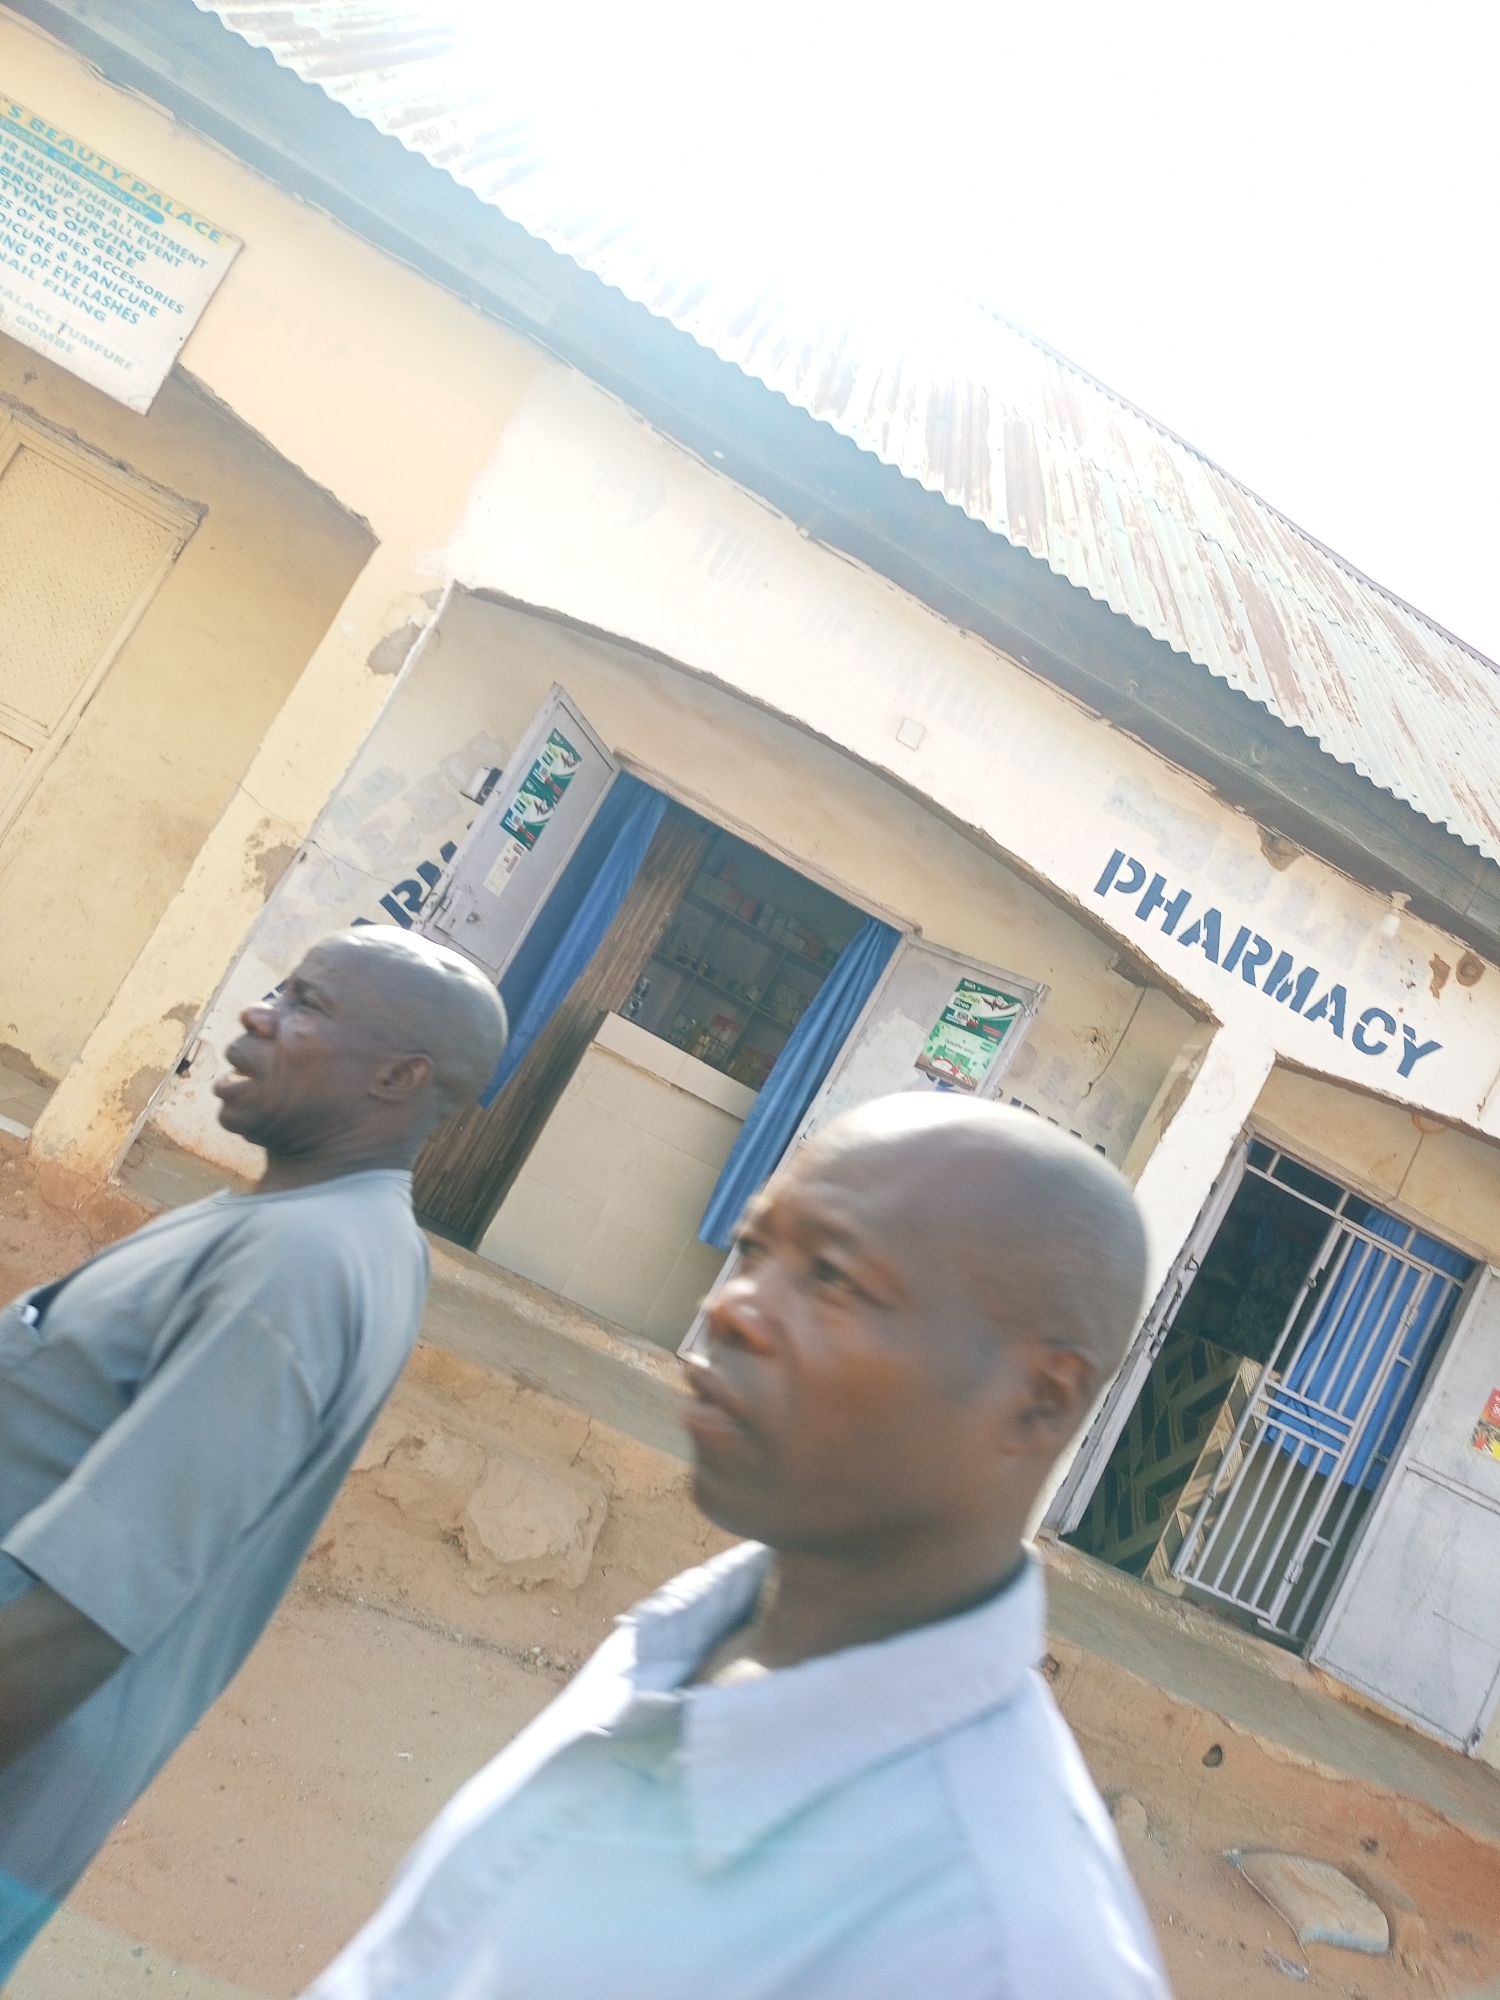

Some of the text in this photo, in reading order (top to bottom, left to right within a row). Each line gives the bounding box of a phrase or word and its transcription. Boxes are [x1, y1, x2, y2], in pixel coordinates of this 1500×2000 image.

[0, 134, 19, 153] IR
[22, 149, 122, 217] MAKING/HAIR
[127, 213, 208, 269] TREATMENT
[0, 165, 147, 262] BROW CURVING
[1, 151, 44, 183] MAKE
[77, 198, 104, 221] FOR
[108, 218, 132, 238] ALL
[137, 234, 184, 268] EVENT
[1, 178, 136, 269] TYING OF GELE
[29, 117, 125, 180] BEAUTY
[131, 180, 222, 244] PALACE
[16, 207, 36, 222] OF
[39, 220, 90, 256] LADIES
[92, 254, 184, 314] ACCESSORIES
[30, 252, 51, 269] OF
[52, 265, 81, 289] EYE
[82, 283, 140, 324] LASHES
[42, 277, 106, 322] FIXING
[56, 251, 68, 263] &
[74, 259, 159, 318] MANICURE
[0, 284, 134, 371] ALACE TUMFURE
[16, 314, 75, 354] GOMBE
[1093, 849, 1443, 1079] PHARMACY
